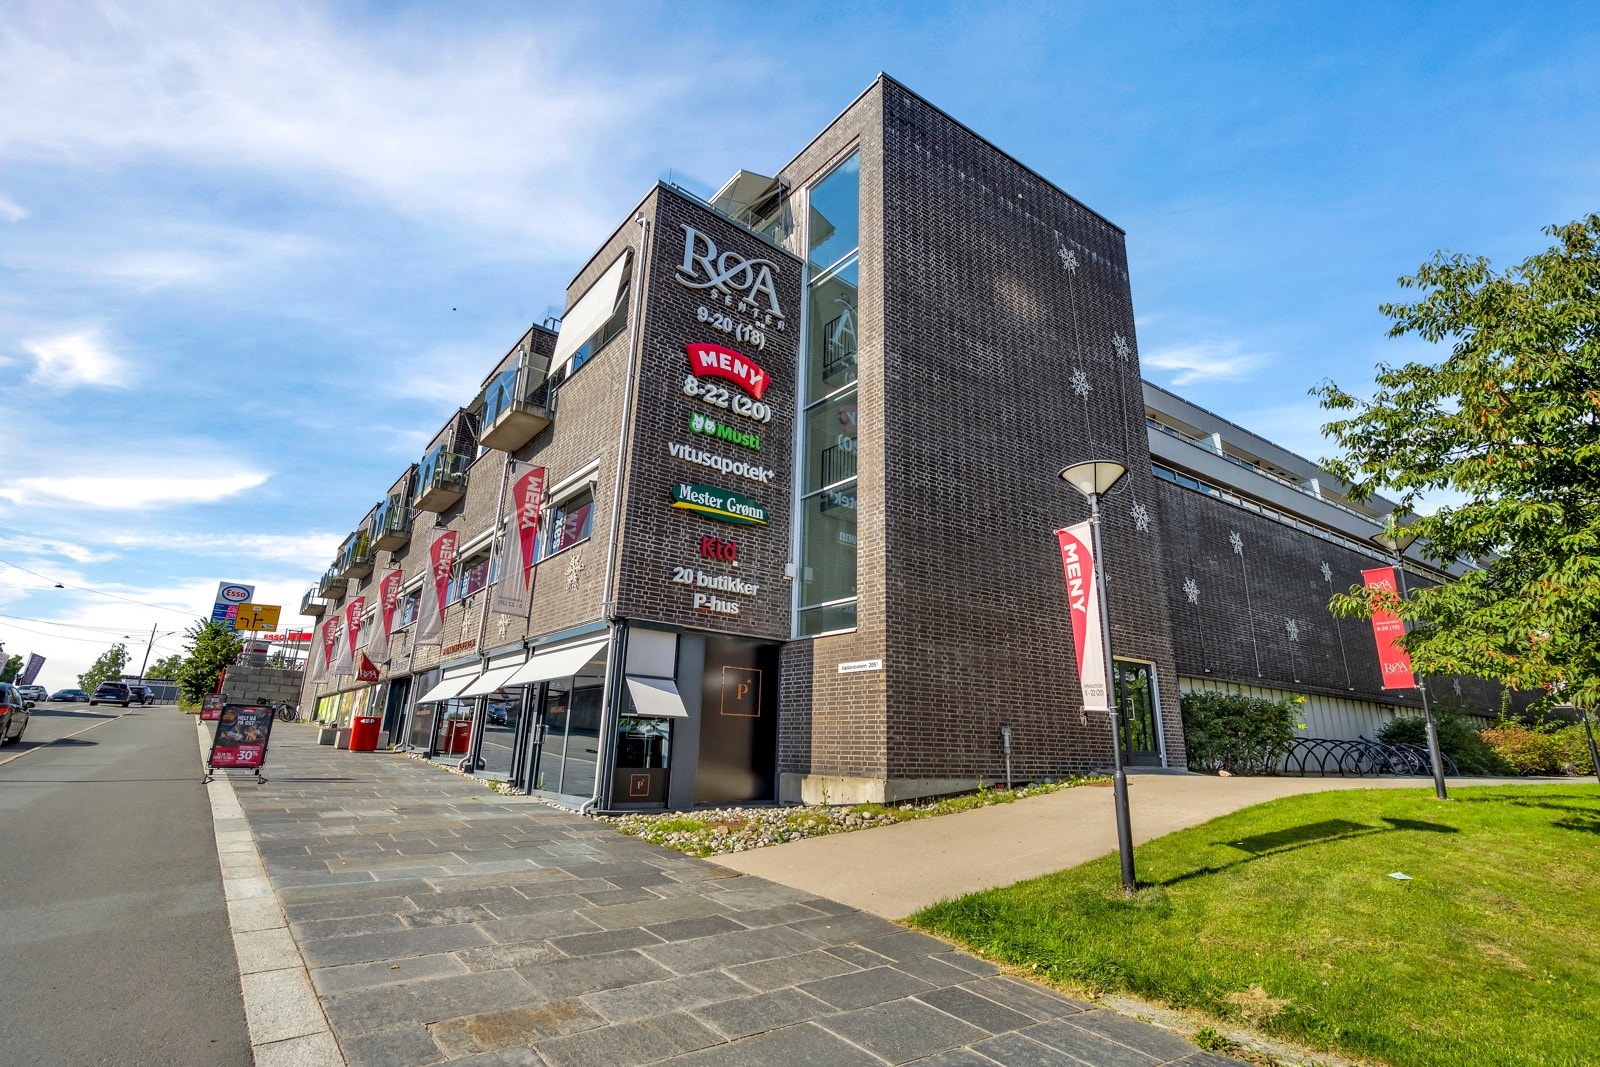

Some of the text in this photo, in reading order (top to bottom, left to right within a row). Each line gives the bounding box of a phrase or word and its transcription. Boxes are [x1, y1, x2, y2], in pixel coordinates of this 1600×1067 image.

[711, 289, 785, 331] SENTER
[697, 306, 765, 350] 9-20 (18)
[699, 351, 763, 386] MENY
[683, 375, 770, 423] 8-22 (20)
[716, 423, 760, 452] Musti
[679, 484, 763, 519] Mester Grønn
[672, 567, 759, 596] 20 butikker
[1063, 542, 1087, 613] MENY
[693, 593, 739, 614] P-hus
[737, 683, 748, 700] P
